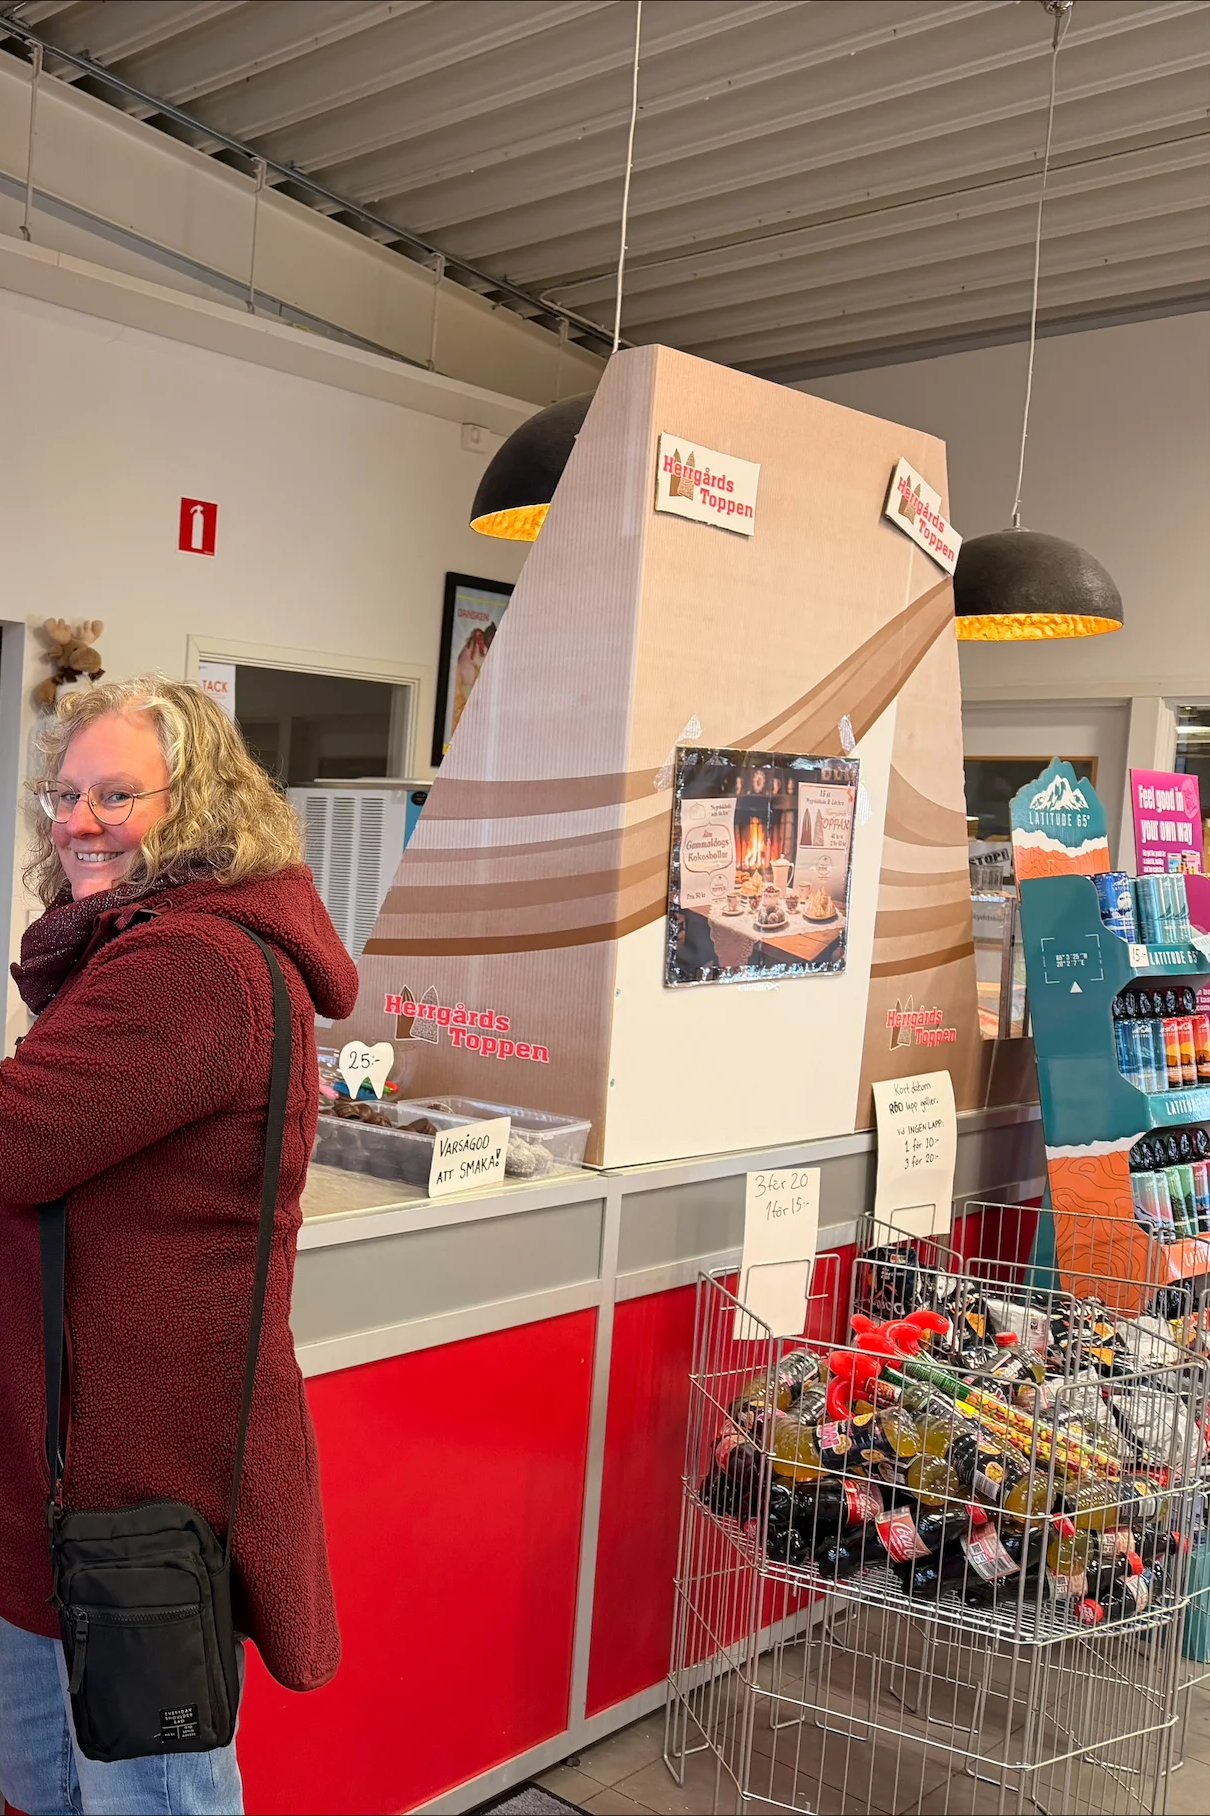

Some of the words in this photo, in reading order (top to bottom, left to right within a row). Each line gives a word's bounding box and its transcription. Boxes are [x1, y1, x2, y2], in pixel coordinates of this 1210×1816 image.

[663, 455, 734, 493] Herrgårds
[700, 487, 753, 518] Toppen
[897, 476, 945, 533] Herrgårds
[919, 518, 955, 562] Toppen
[202, 680, 228, 693] TACK
[1138, 784, 1155, 809] Feel
[1155, 788, 1176, 813] good
[1174, 786, 1185, 812] in
[1029, 811, 1072, 827] LATITUDE
[1140, 820, 1158, 843] your
[1160, 821, 1177, 842] own
[1176, 822, 1192, 845] way
[1150, 951, 1185, 965] LATITUDE
[384, 994, 510, 1031] Herrgårds
[886, 1005, 943, 1030] Herrgårds
[448, 1027, 549, 1063] Toppen
[915, 1027, 957, 1048] Toppen
[348, 1051, 380, 1069] 25:-
[894, 1083, 910, 1096] Kort
[908, 1123, 927, 1135] INGEN
[439, 1134, 490, 1157] VARSÅGOD
[905, 1140, 910, 1153] 1
[436, 1170, 454, 1184] ATT
[459, 1148, 501, 1179] SMAKA!
[904, 1158, 909, 1170] 3
[790, 1172, 809, 1190] 20
[791, 1196, 810, 1215] 15:-
